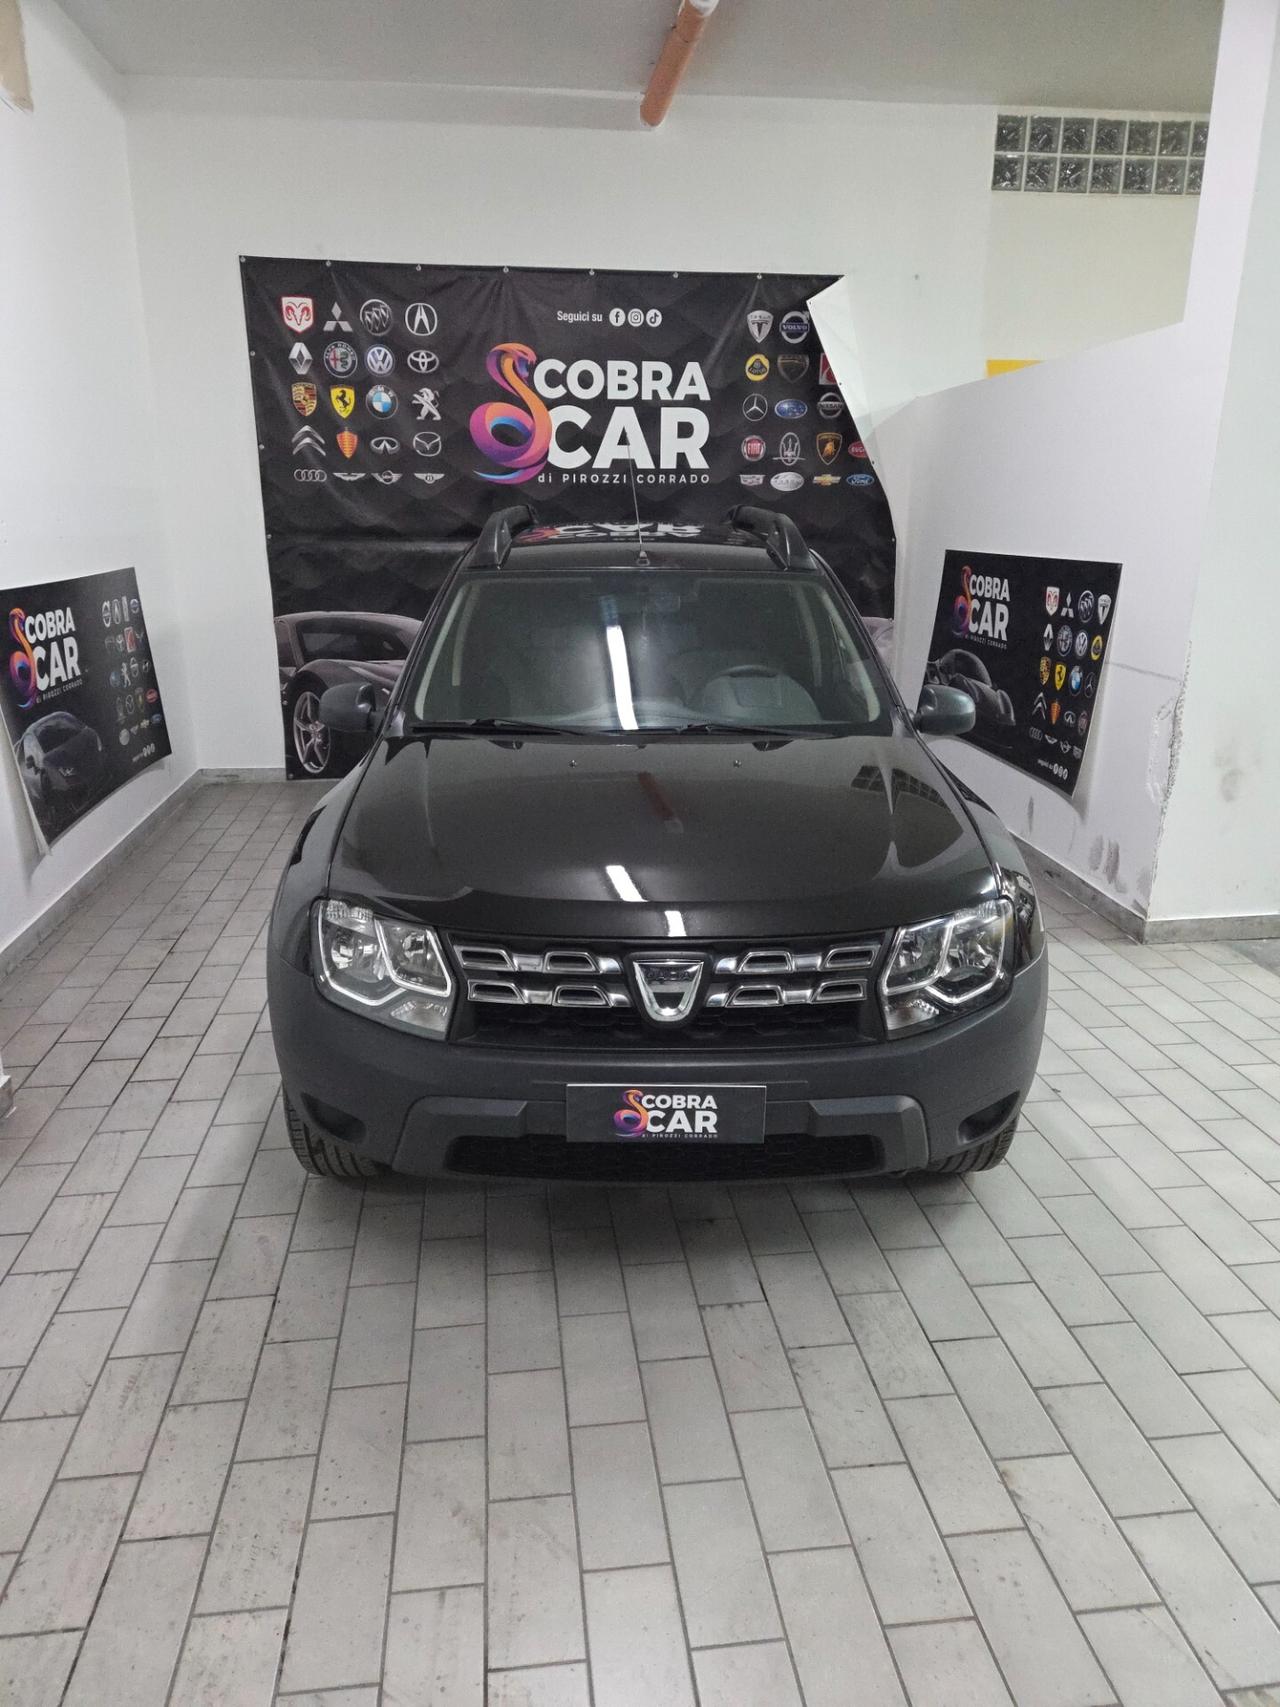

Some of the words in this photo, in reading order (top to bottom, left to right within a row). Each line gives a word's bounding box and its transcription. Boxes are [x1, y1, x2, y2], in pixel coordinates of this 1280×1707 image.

[557, 310, 590, 323] Seguici
[591, 313, 603, 322] su
[533, 358, 711, 401] COBRA
[547, 404, 711, 470] CAR
[538, 474, 552, 483] di
[562, 474, 628, 484] PIROZZI
[636, 474, 711, 484] CORRADO
[969, 574, 1011, 602] COBRA
[25, 606, 76, 645] COBRA
[968, 598, 1010, 642] CAR
[32, 636, 82, 692] CAR
[641, 1094, 718, 1109] COBRA
[646, 1110, 718, 1133] CAR
